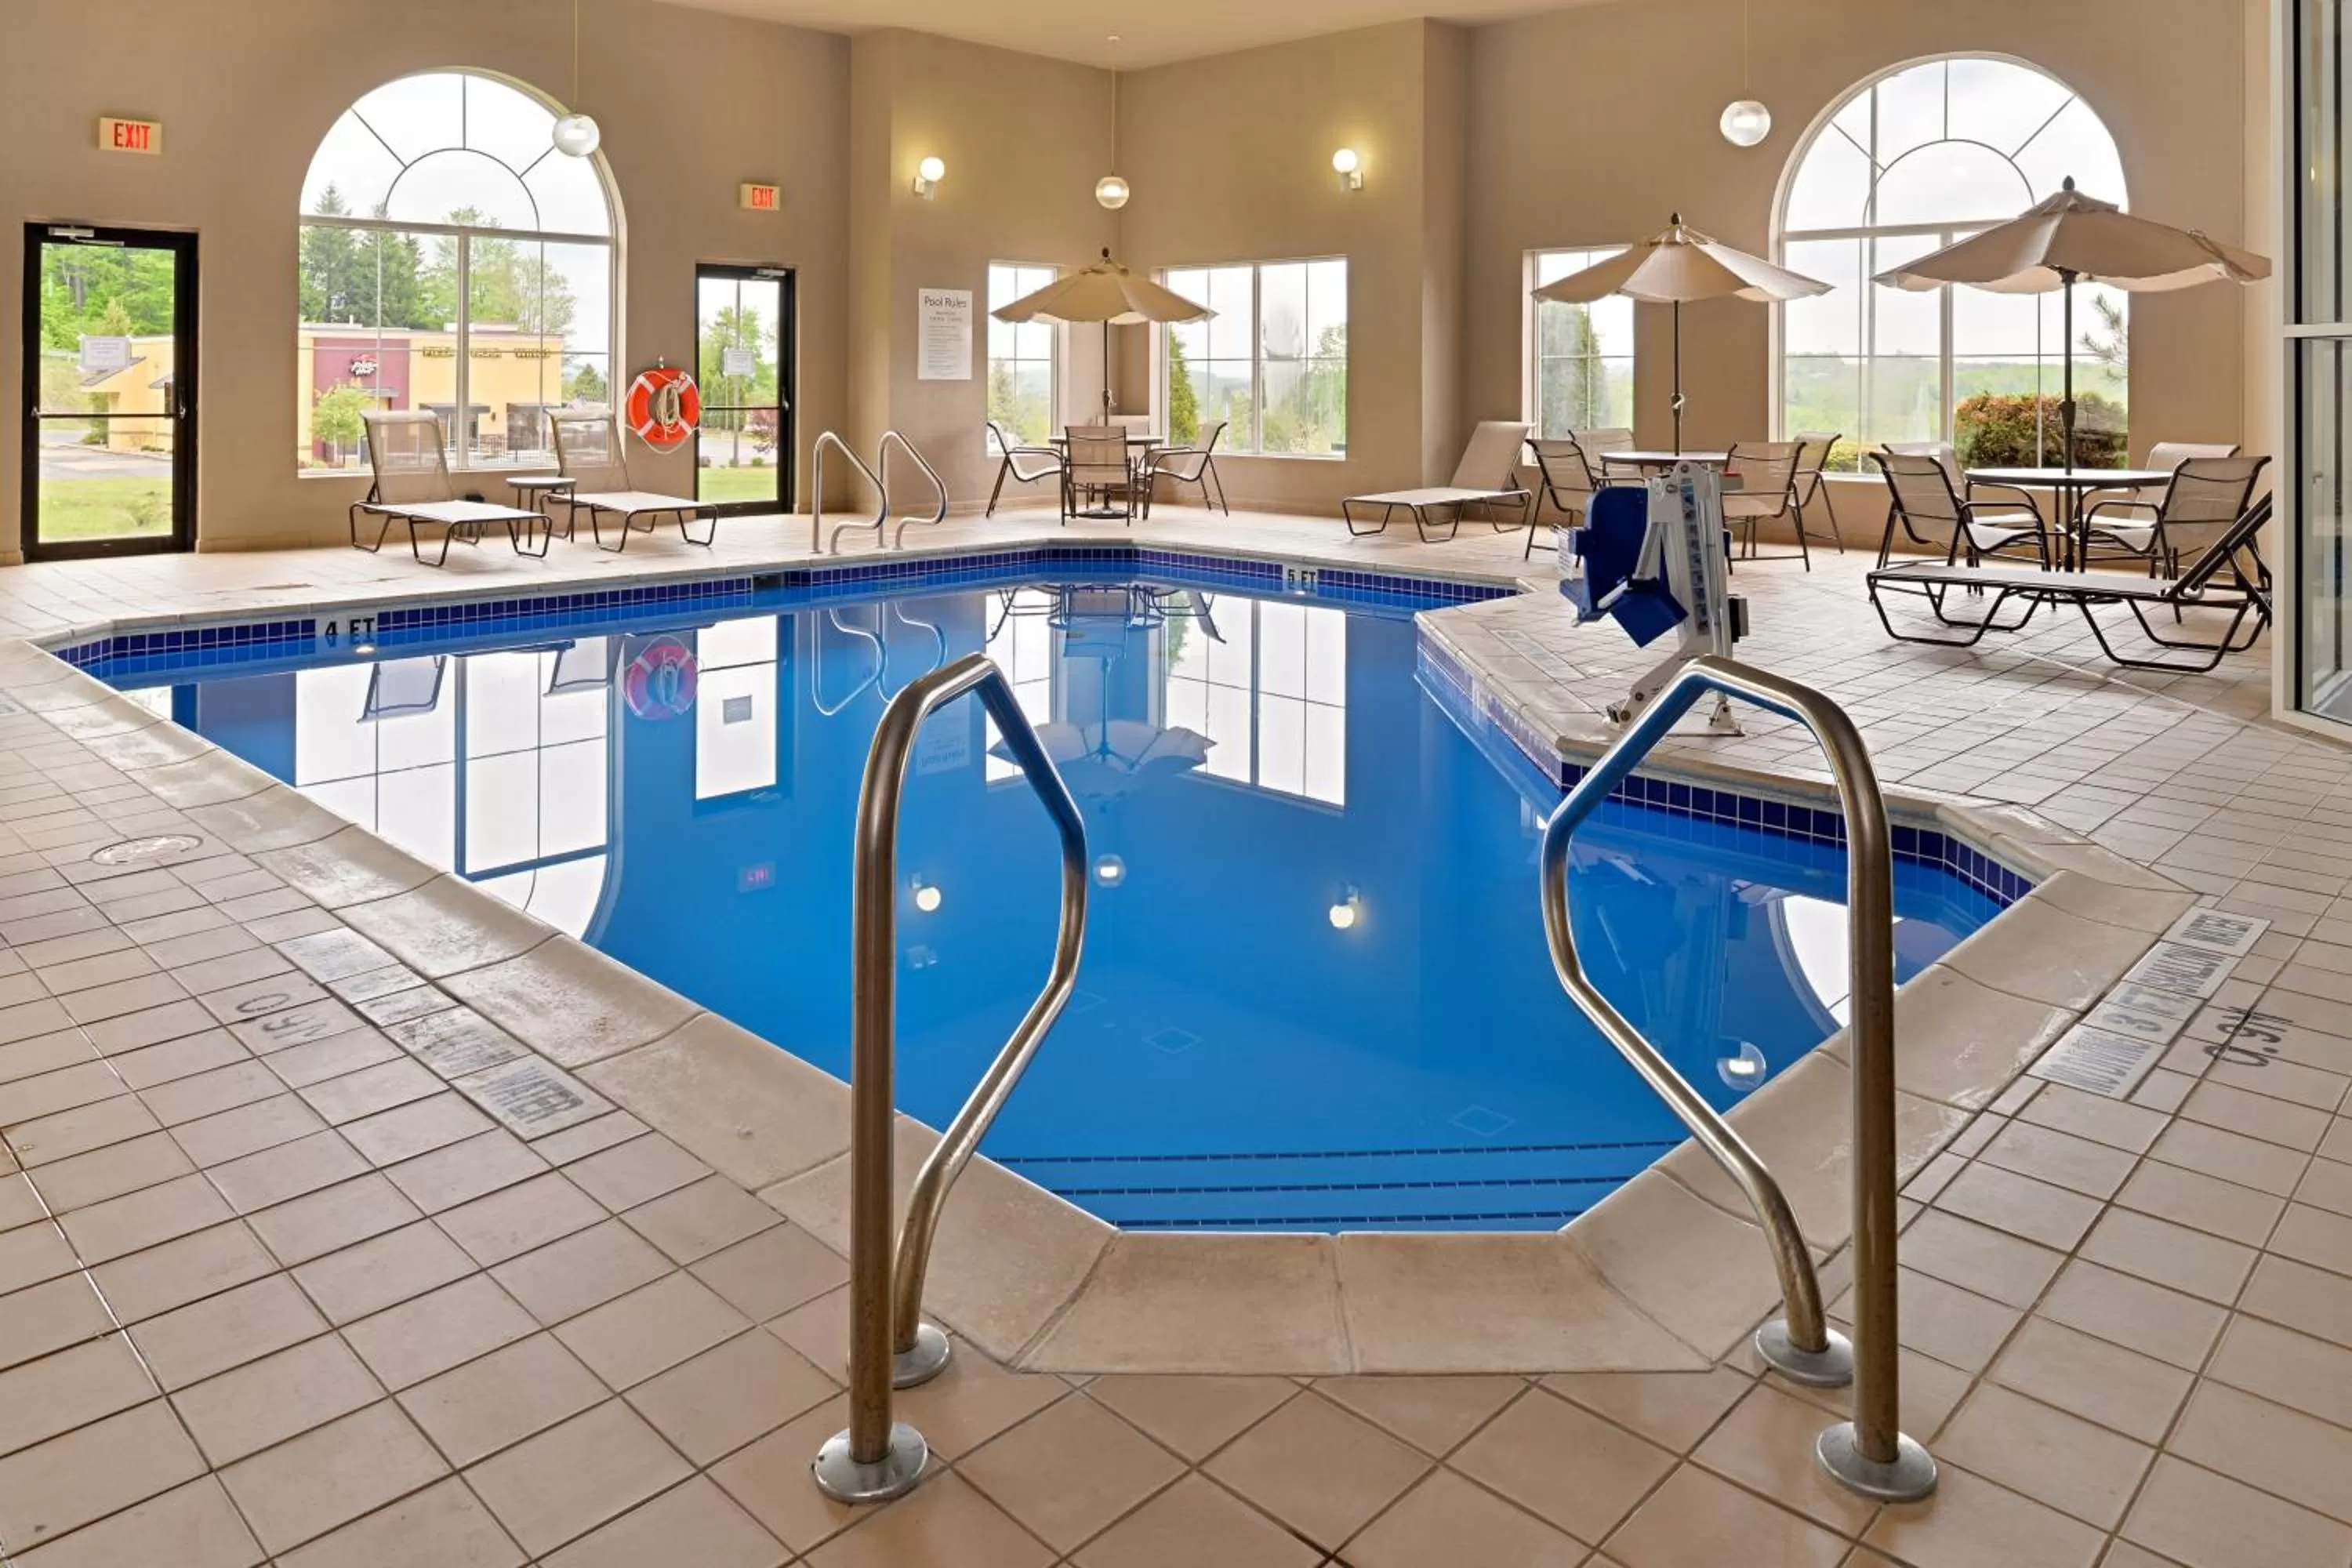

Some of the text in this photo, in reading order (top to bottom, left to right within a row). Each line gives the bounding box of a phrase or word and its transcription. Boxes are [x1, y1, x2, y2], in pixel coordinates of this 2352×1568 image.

[114, 122, 151, 151] EXIT
[752, 187, 774, 207] EXIT
[924, 296, 967, 308] Pool Rules
[1288, 569, 1316, 583] 5 FT
[325, 618, 375, 636] 4 FT
